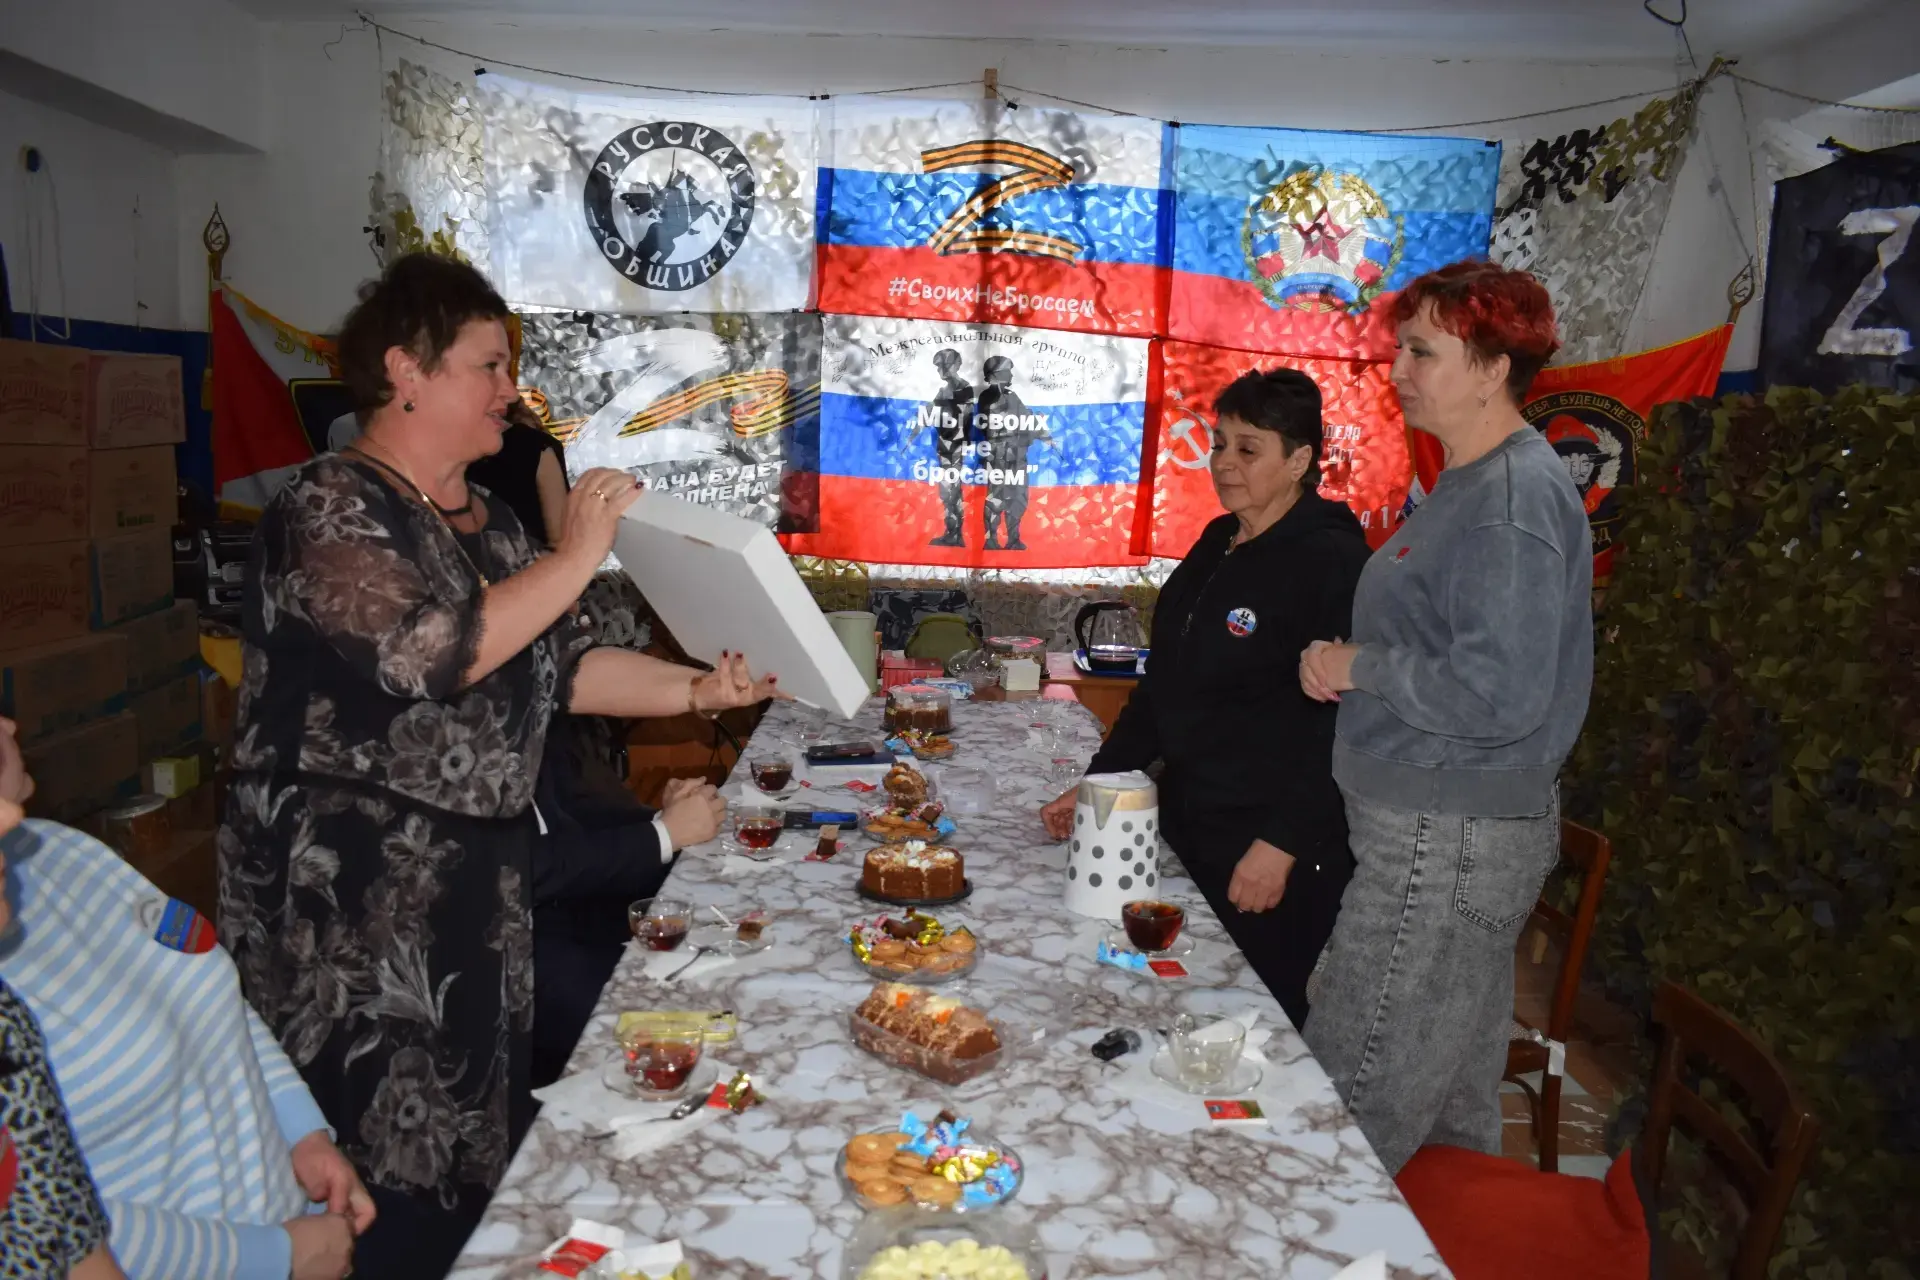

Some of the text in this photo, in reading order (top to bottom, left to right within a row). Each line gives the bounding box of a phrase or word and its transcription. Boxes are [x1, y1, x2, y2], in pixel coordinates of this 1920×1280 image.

[595, 122, 749, 181] РУССКАЯ
[603, 235, 737, 289] ОБЩИНА
[887, 276, 1096, 315] #СвоихНеБросаем
[867, 331, 1024, 359] Межрегиональная
[1031, 340, 1087, 365] группа
[1559, 394, 1612, 410] БУДЕШЬ
[972, 412, 1050, 431] своих
[961, 439, 992, 457] не
[707, 460, 788, 486] БУДЕТ
